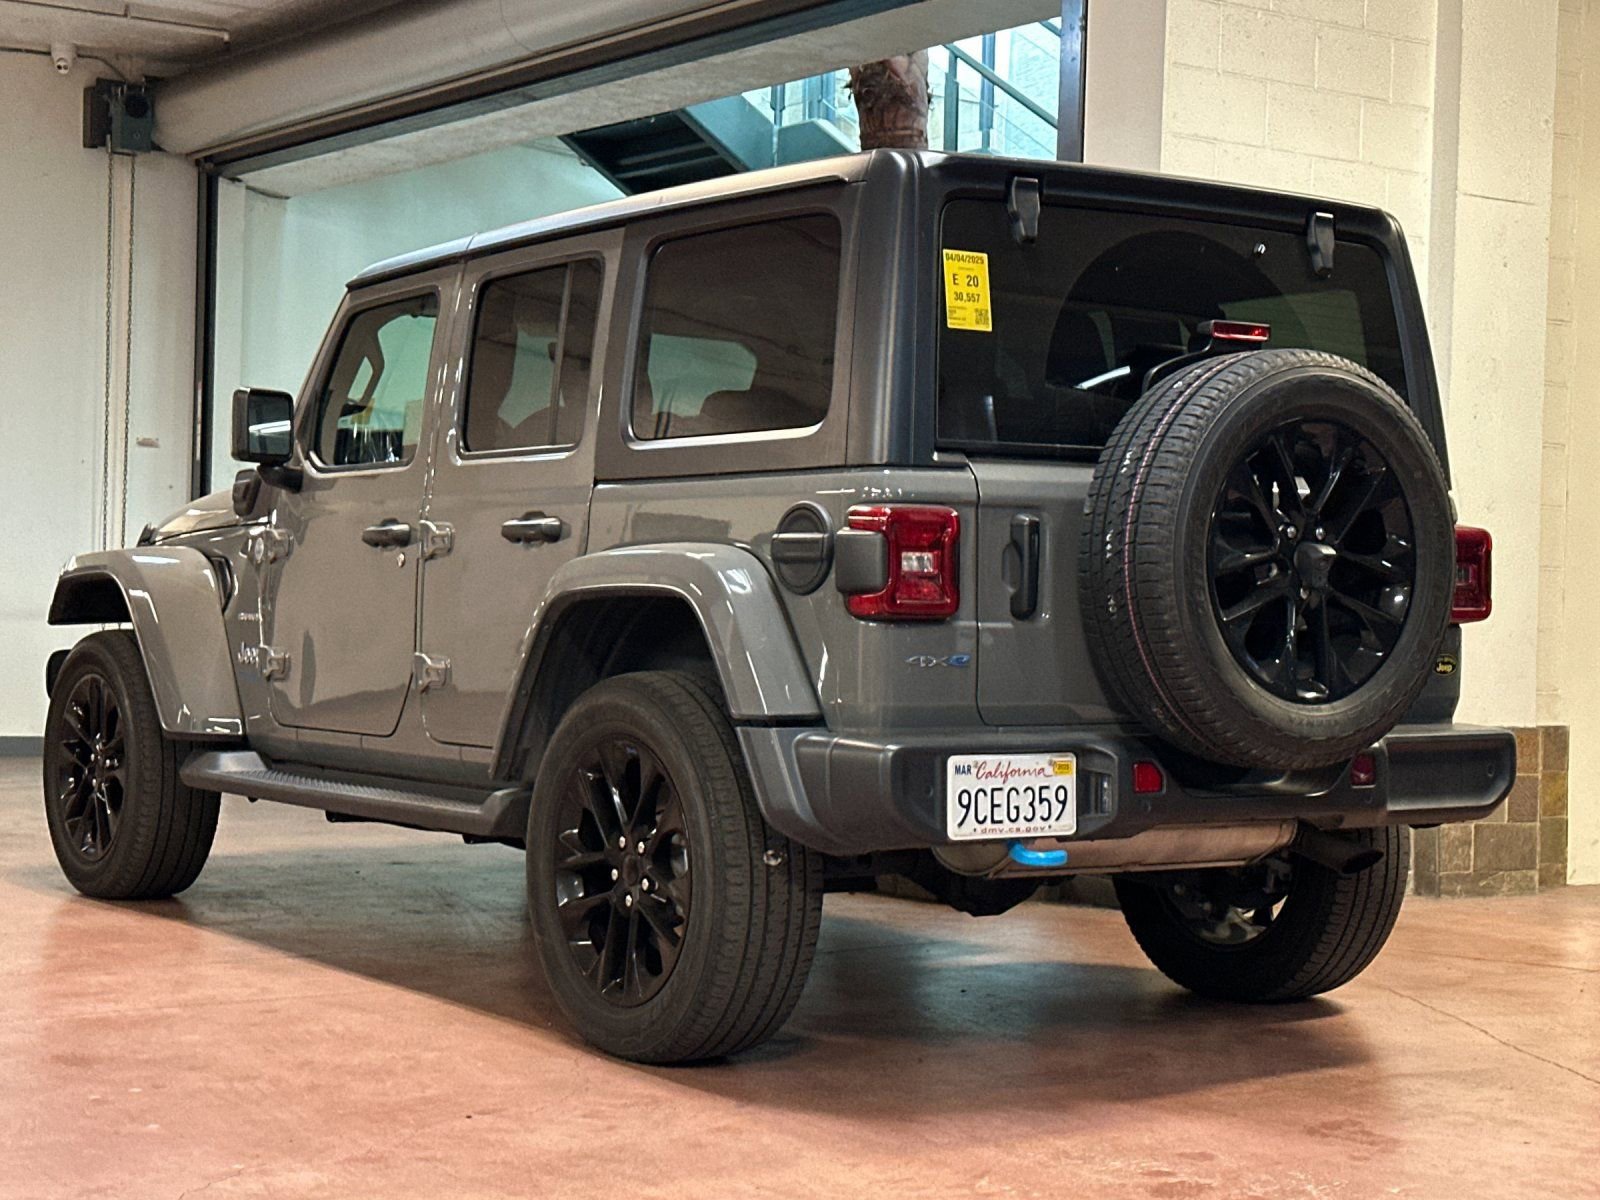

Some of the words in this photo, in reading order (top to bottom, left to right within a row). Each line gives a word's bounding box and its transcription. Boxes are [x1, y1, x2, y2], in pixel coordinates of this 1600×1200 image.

[945, 253, 984, 264] 04/04/2025
[953, 274, 959, 285] E
[966, 275, 979, 287] 20
[954, 764, 972, 776] MAR
[975, 760, 1053, 785] California
[957, 784, 1068, 829] 9CEG359
[980, 825, 1047, 835] dmv.ca.gov
